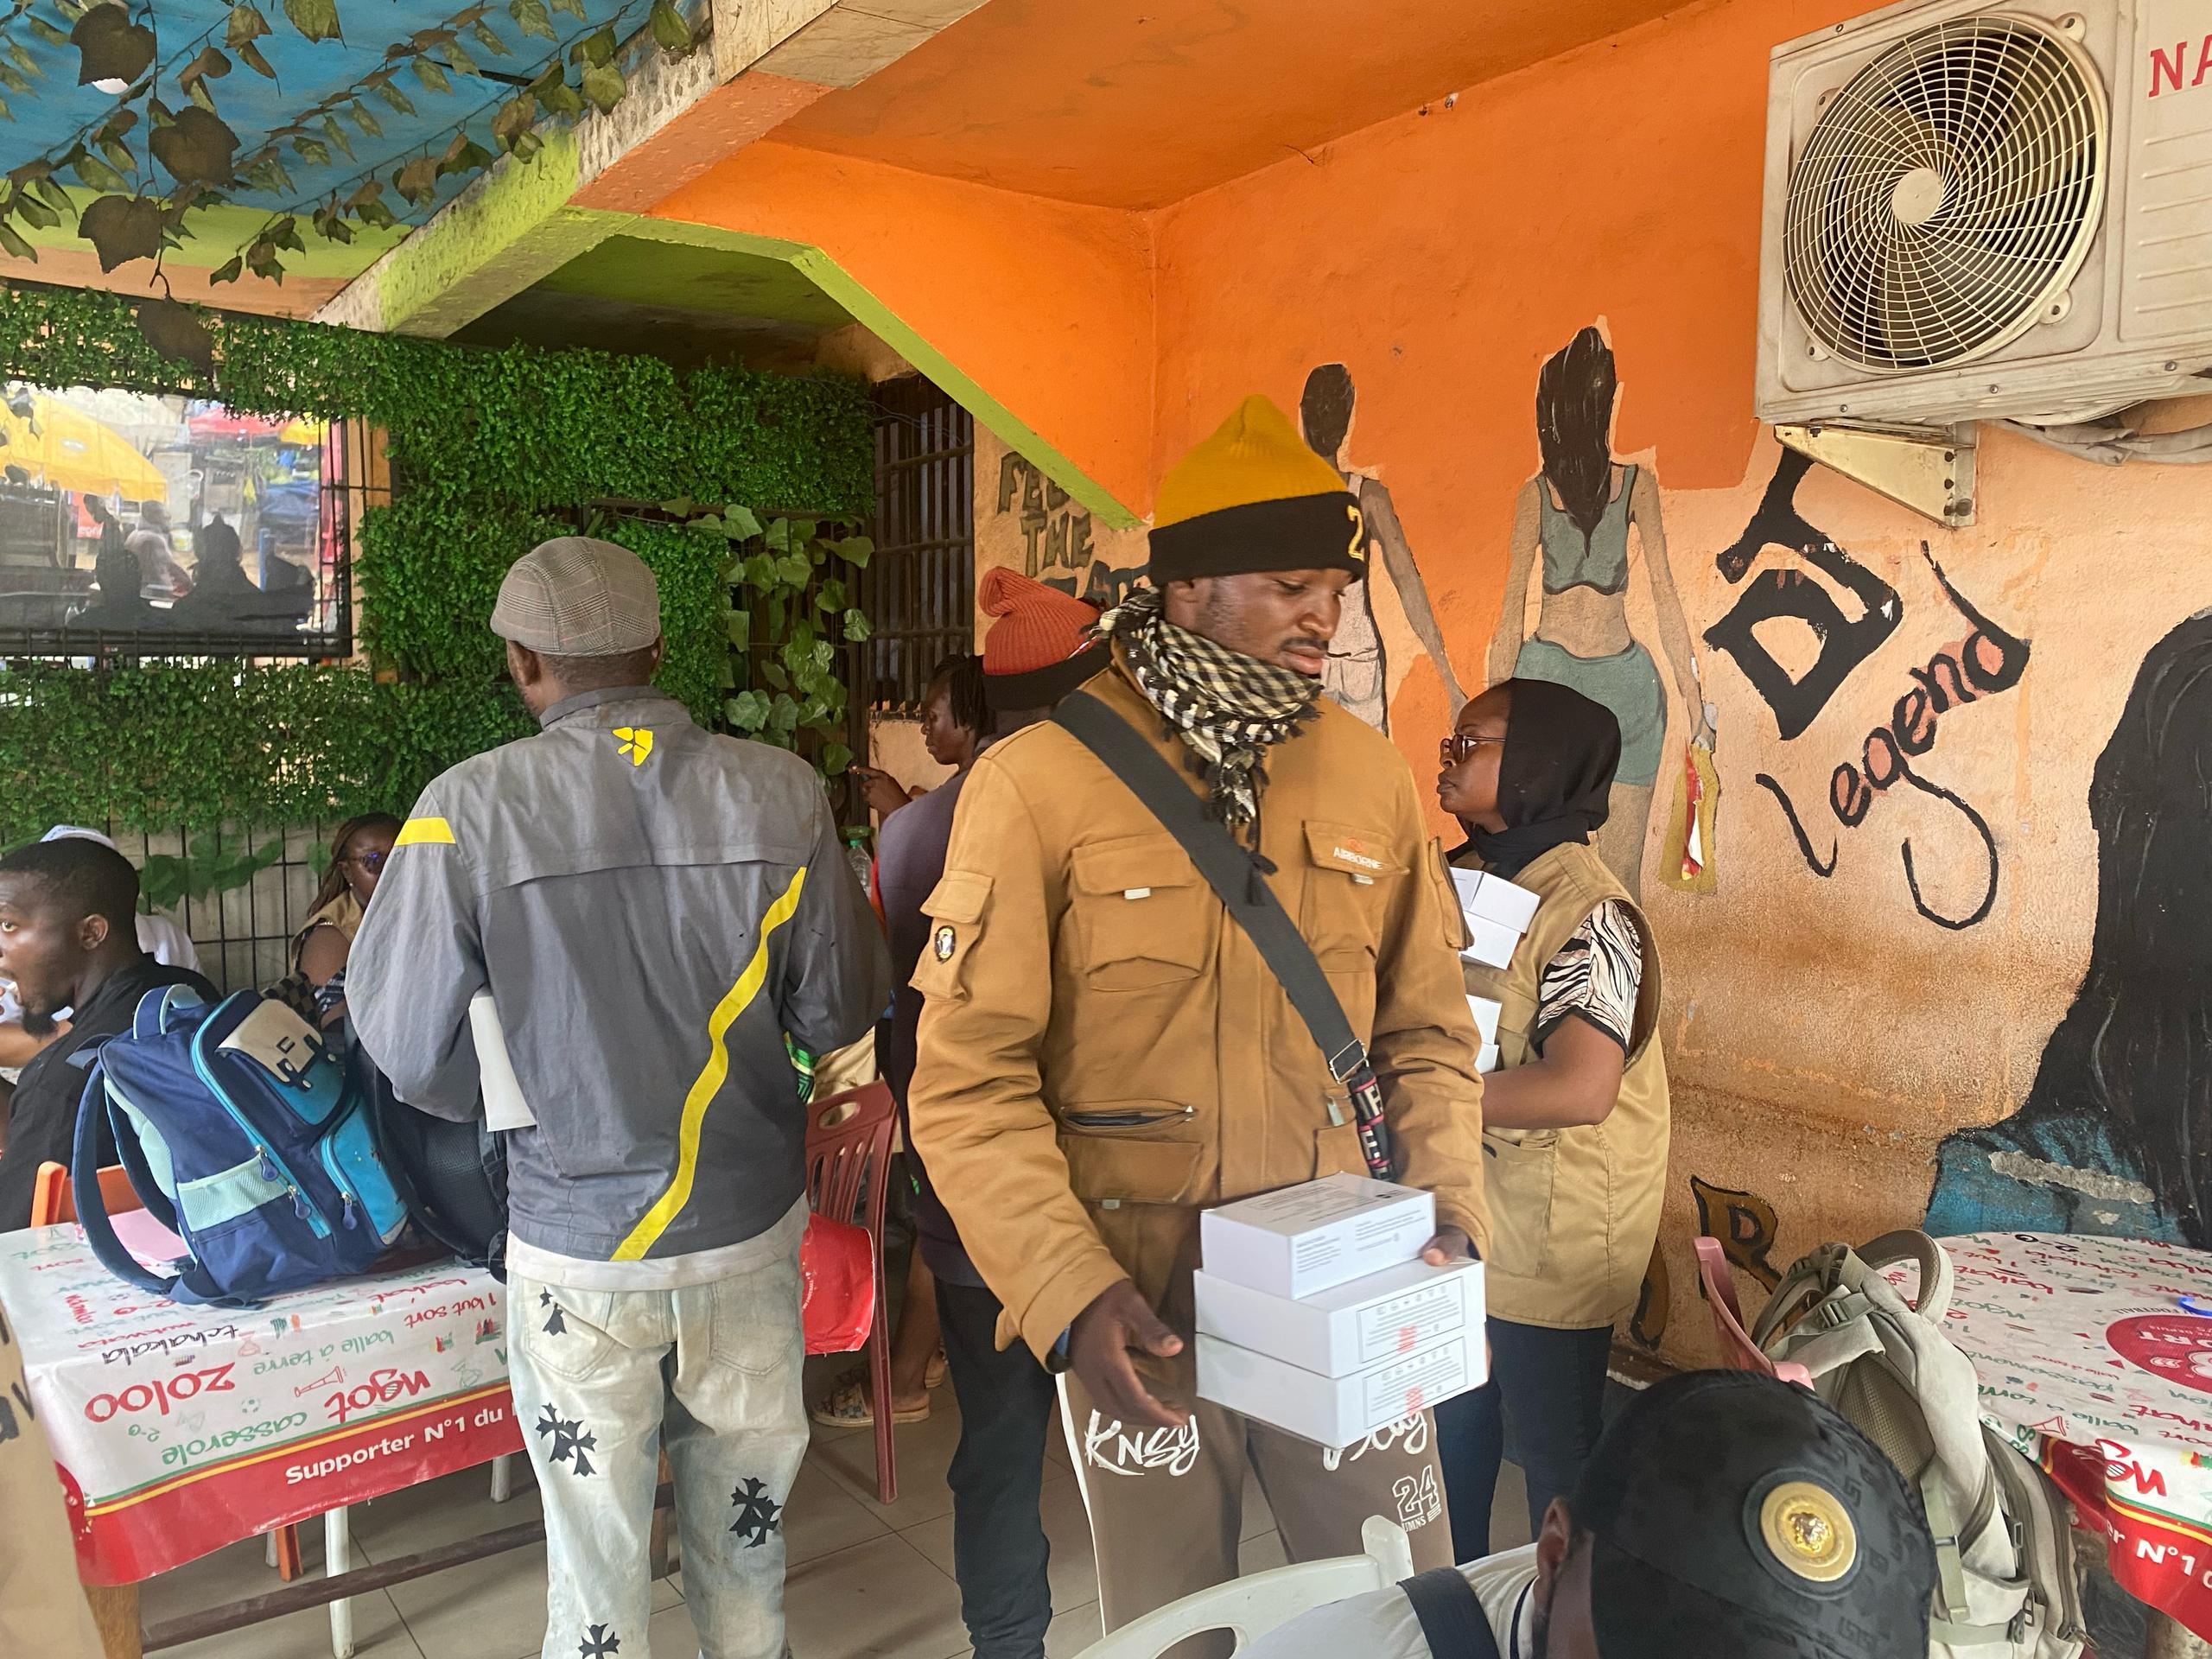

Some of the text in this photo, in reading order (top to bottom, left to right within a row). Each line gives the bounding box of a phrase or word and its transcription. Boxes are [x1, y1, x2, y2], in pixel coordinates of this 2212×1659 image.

[404, 1305, 448, 1328] sort
[452, 1296, 485, 1316] but
[341, 1329, 395, 1354] balle
[253, 1351, 314, 1375] terre
[324, 1368, 431, 1425] ngot
[161, 1411, 308, 1466] casserole
[284, 1430, 416, 1485] Supporter
[474, 1408, 503, 1427] du
[1392, 1464, 1441, 1522] 24
